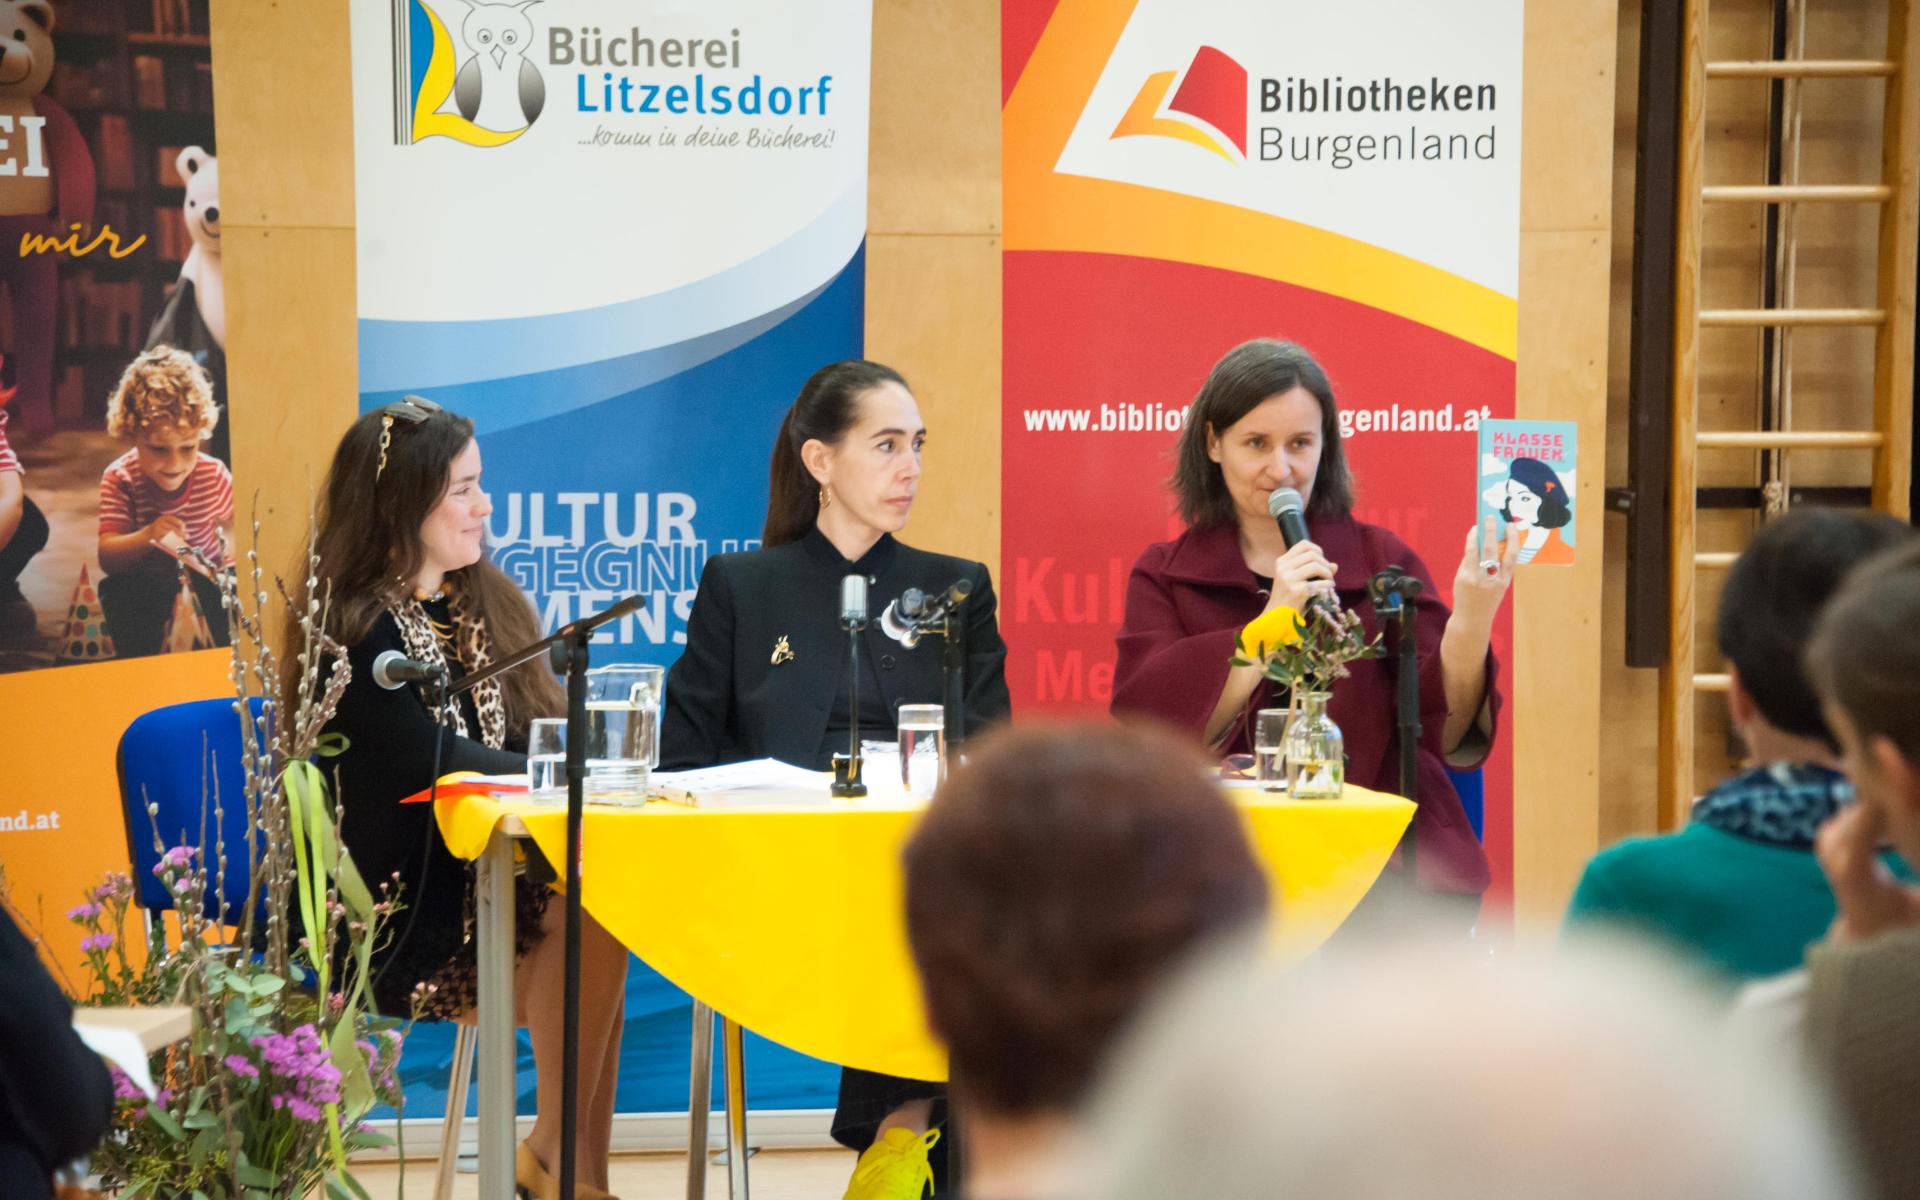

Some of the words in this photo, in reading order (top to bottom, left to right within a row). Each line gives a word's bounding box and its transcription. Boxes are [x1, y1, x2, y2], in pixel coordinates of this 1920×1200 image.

[549, 27, 740, 68] Bücherei
[577, 73, 832, 115] Litzelsdorf
[1260, 76, 1496, 113] Bibliotheken
[659, 126, 677, 146] in
[684, 124, 740, 147] deine
[746, 124, 836, 149] Bücherei!
[1260, 125, 1495, 169] Burgenland
[19, 223, 146, 259] mir
[1493, 432, 1563, 447] KLASSE
[1493, 446, 1563, 461] FRAUEN
